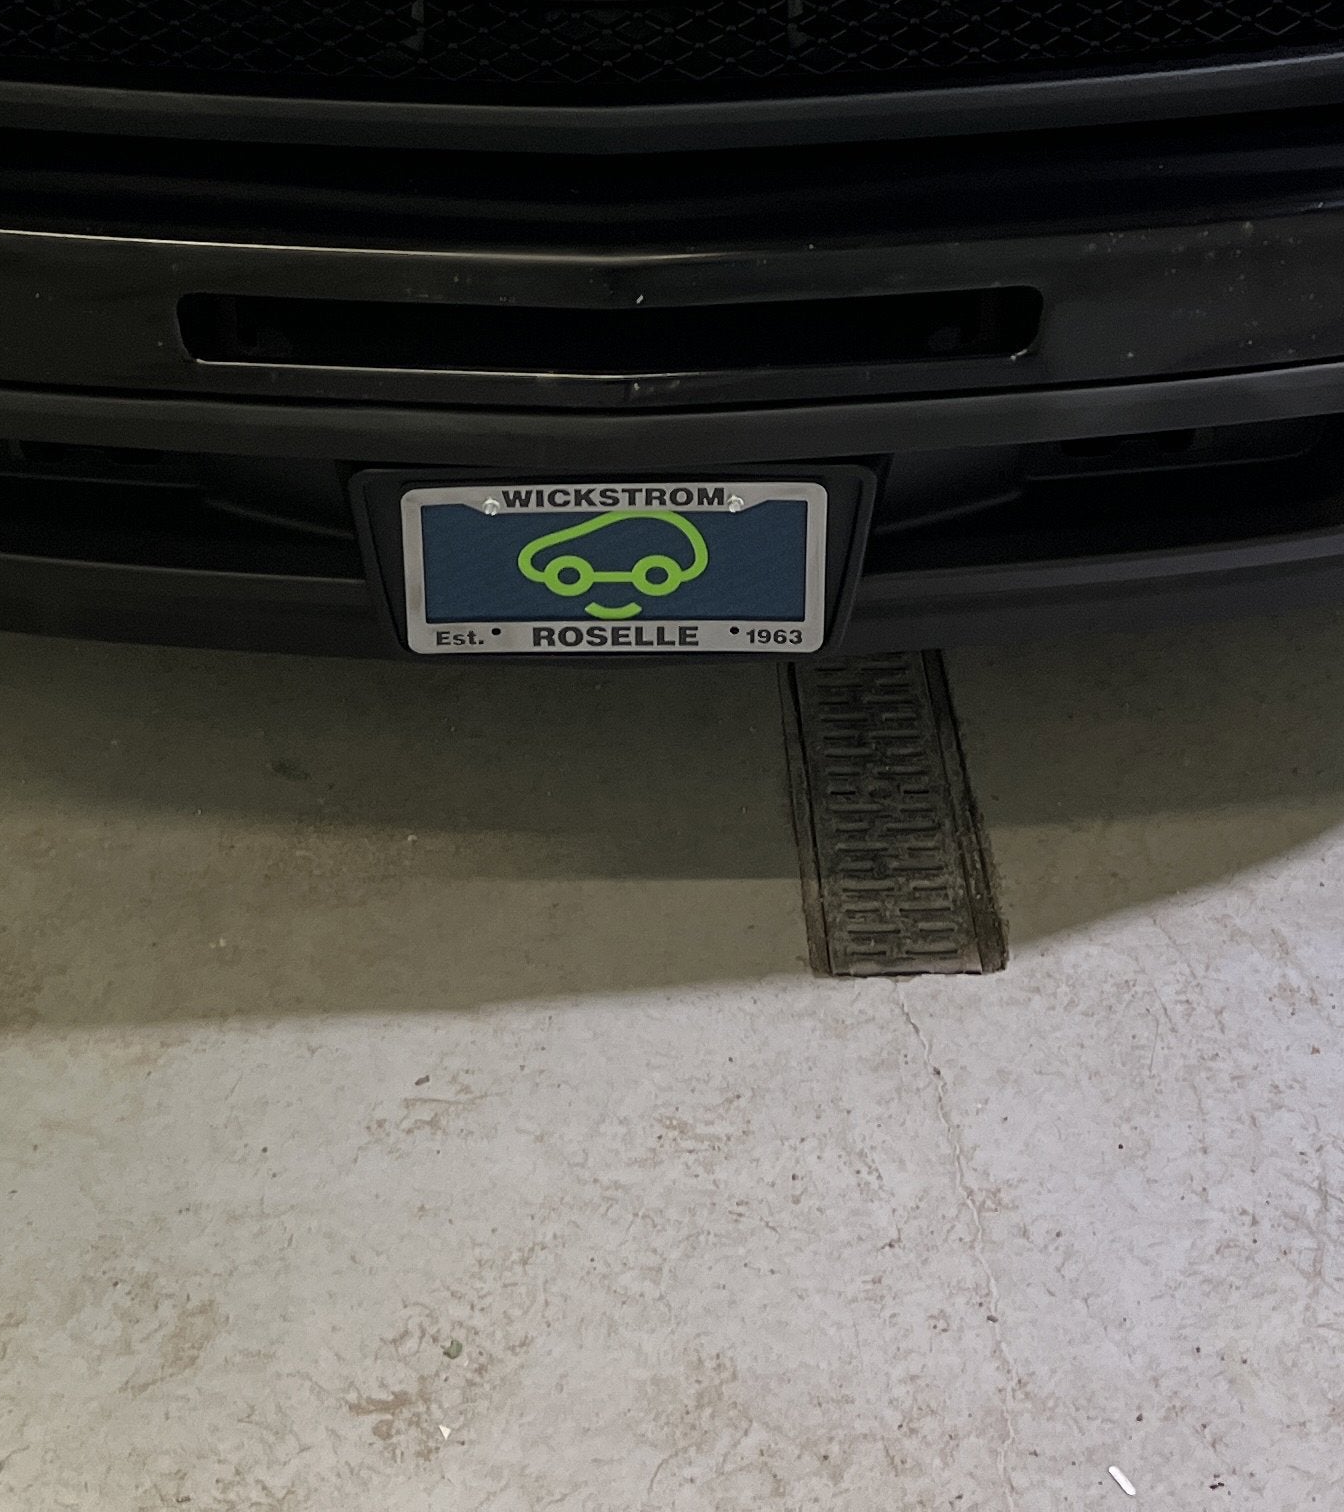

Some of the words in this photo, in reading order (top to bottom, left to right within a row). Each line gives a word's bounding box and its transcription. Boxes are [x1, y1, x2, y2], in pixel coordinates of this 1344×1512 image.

[502, 487, 726, 509] WICKSTROM
[436, 629, 485, 646] Est.
[532, 625, 699, 648] ROSELLE
[746, 628, 804, 645] 1963
